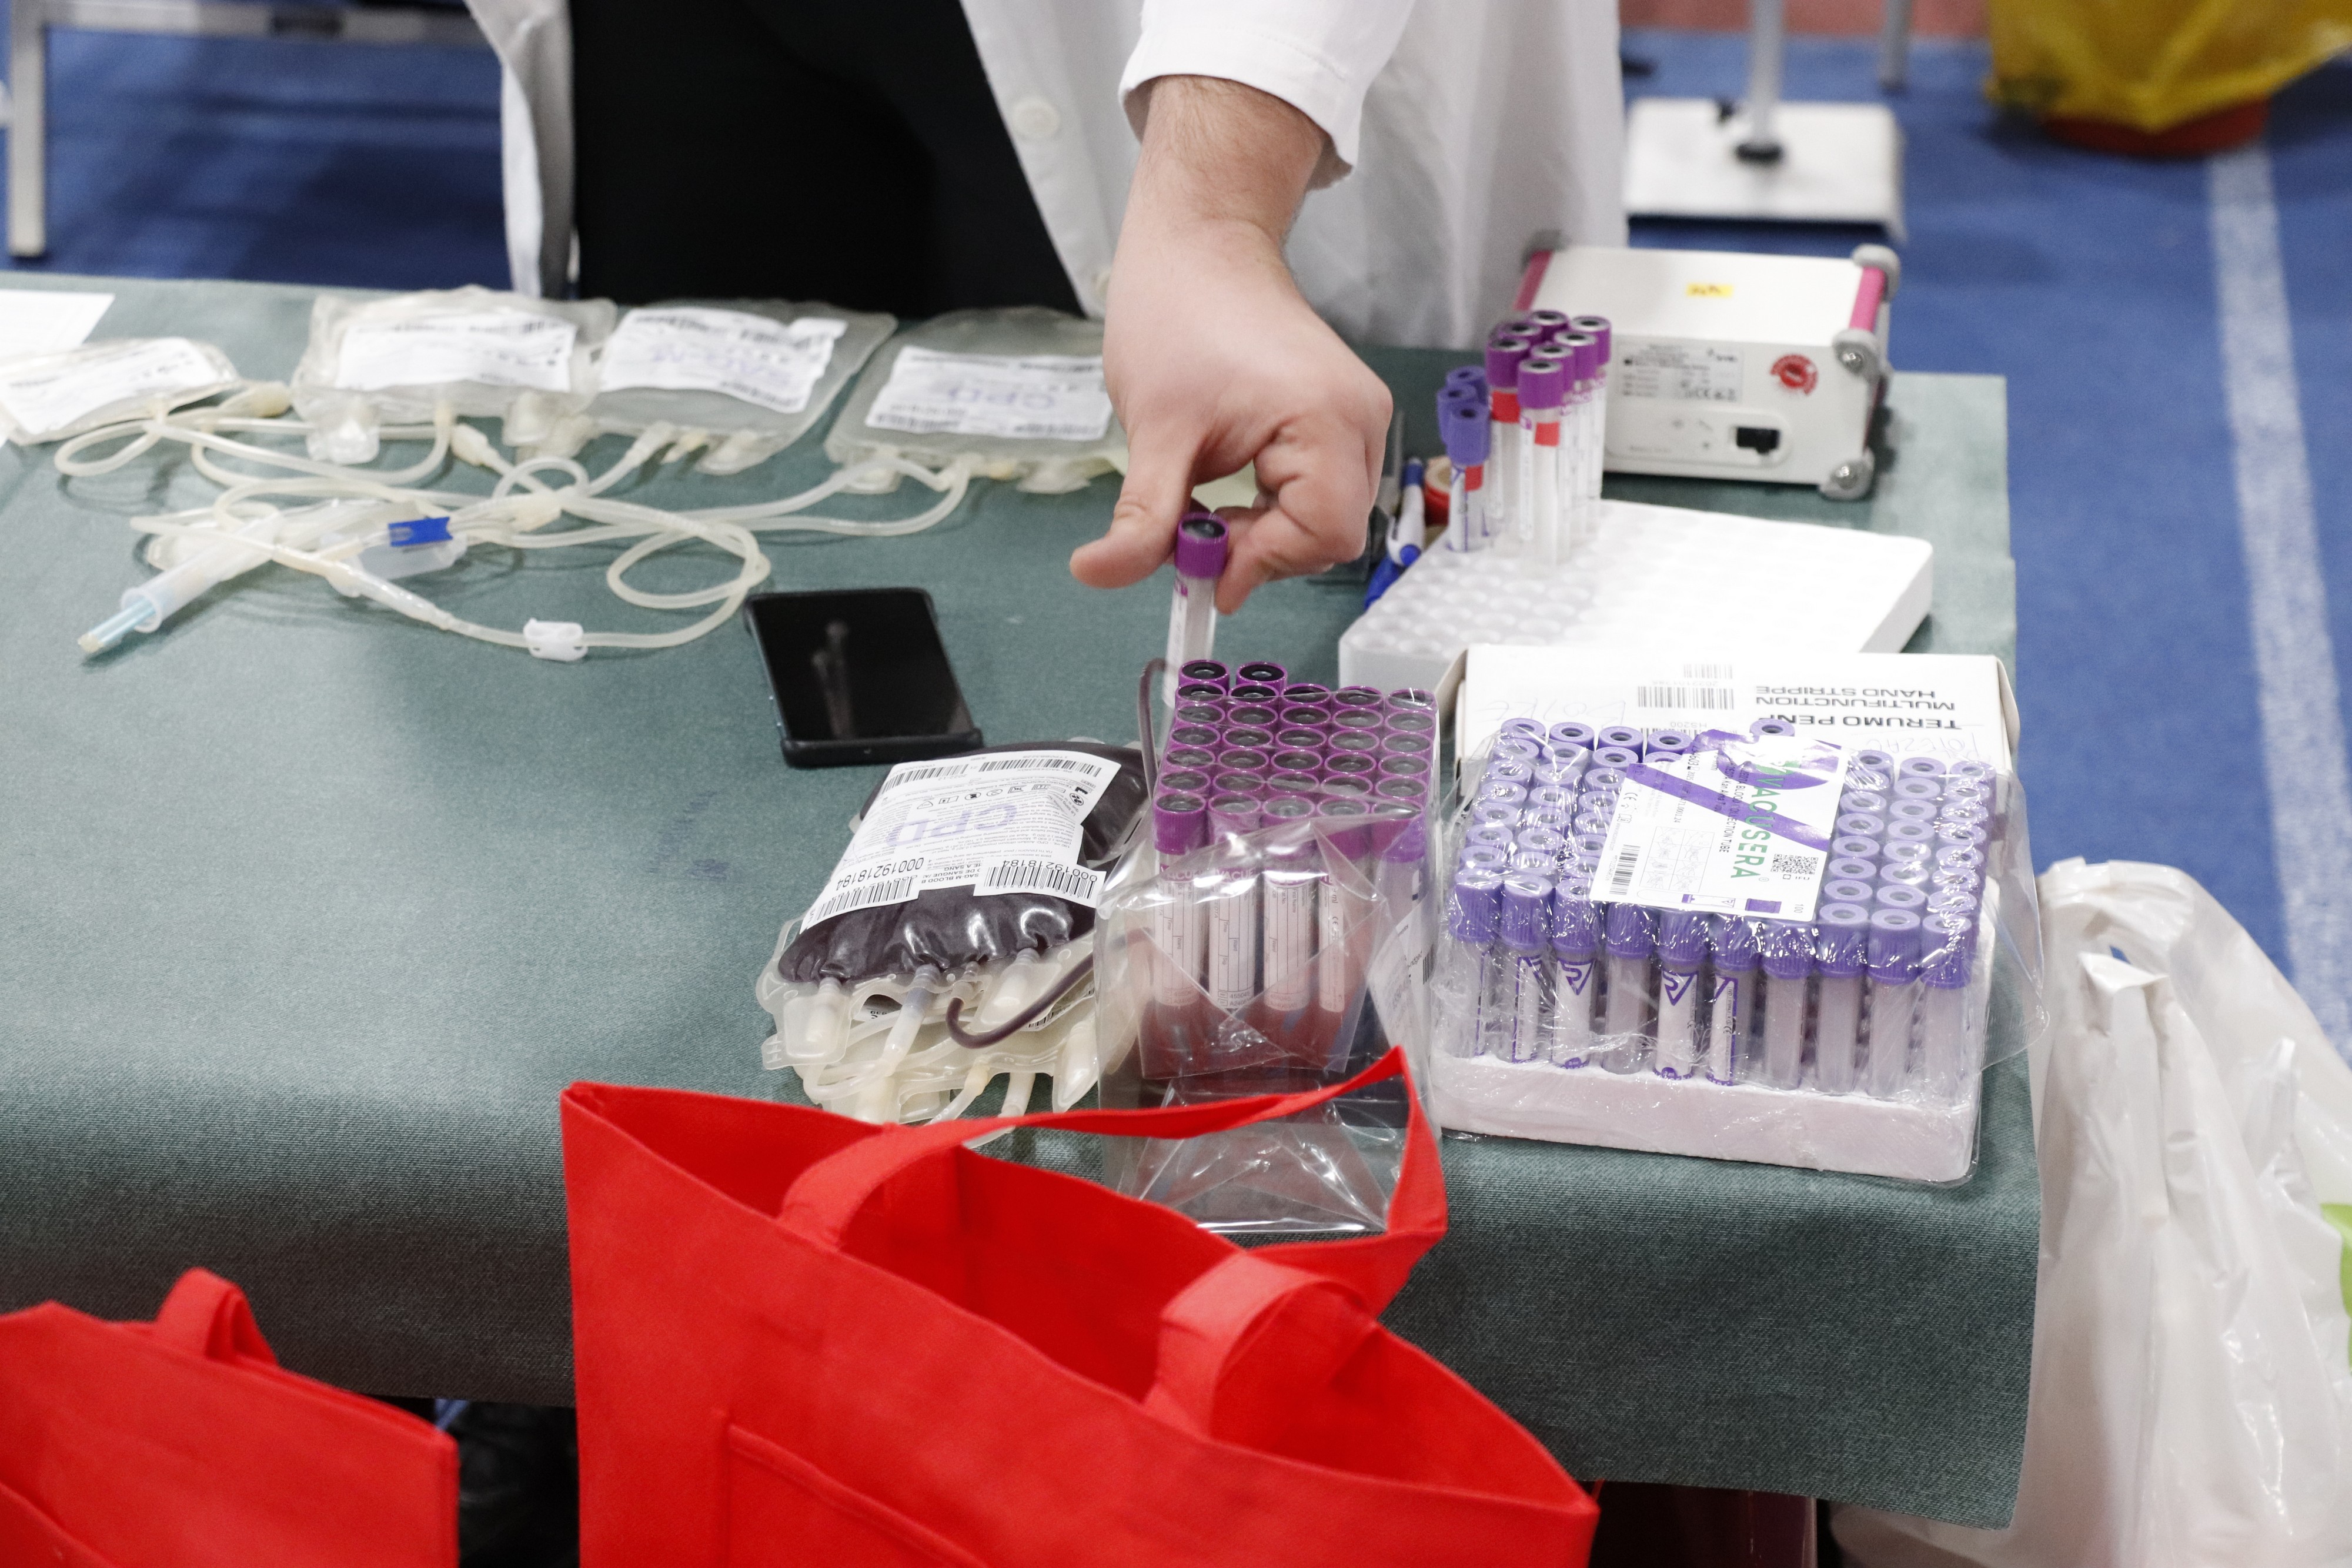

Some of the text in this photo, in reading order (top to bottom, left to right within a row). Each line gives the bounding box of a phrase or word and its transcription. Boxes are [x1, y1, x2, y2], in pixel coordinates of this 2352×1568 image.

[1756, 686, 1935, 698] HAND STRIPPE
[1756, 697, 1955, 710] MULTIFUNCTION
[1843, 716, 1961, 730] TERUMO
[1719, 780, 1732, 789] Kan
[1730, 785, 1745, 804] BLOOD
[886, 802, 1018, 847] CPD
[1730, 777, 1785, 880] VACUSERA
[1718, 839, 1731, 852] TUBE
[836, 857, 924, 891] 00019218184
[1003, 859, 1098, 882] 00019218184
[1792, 903, 1804, 914] 100
